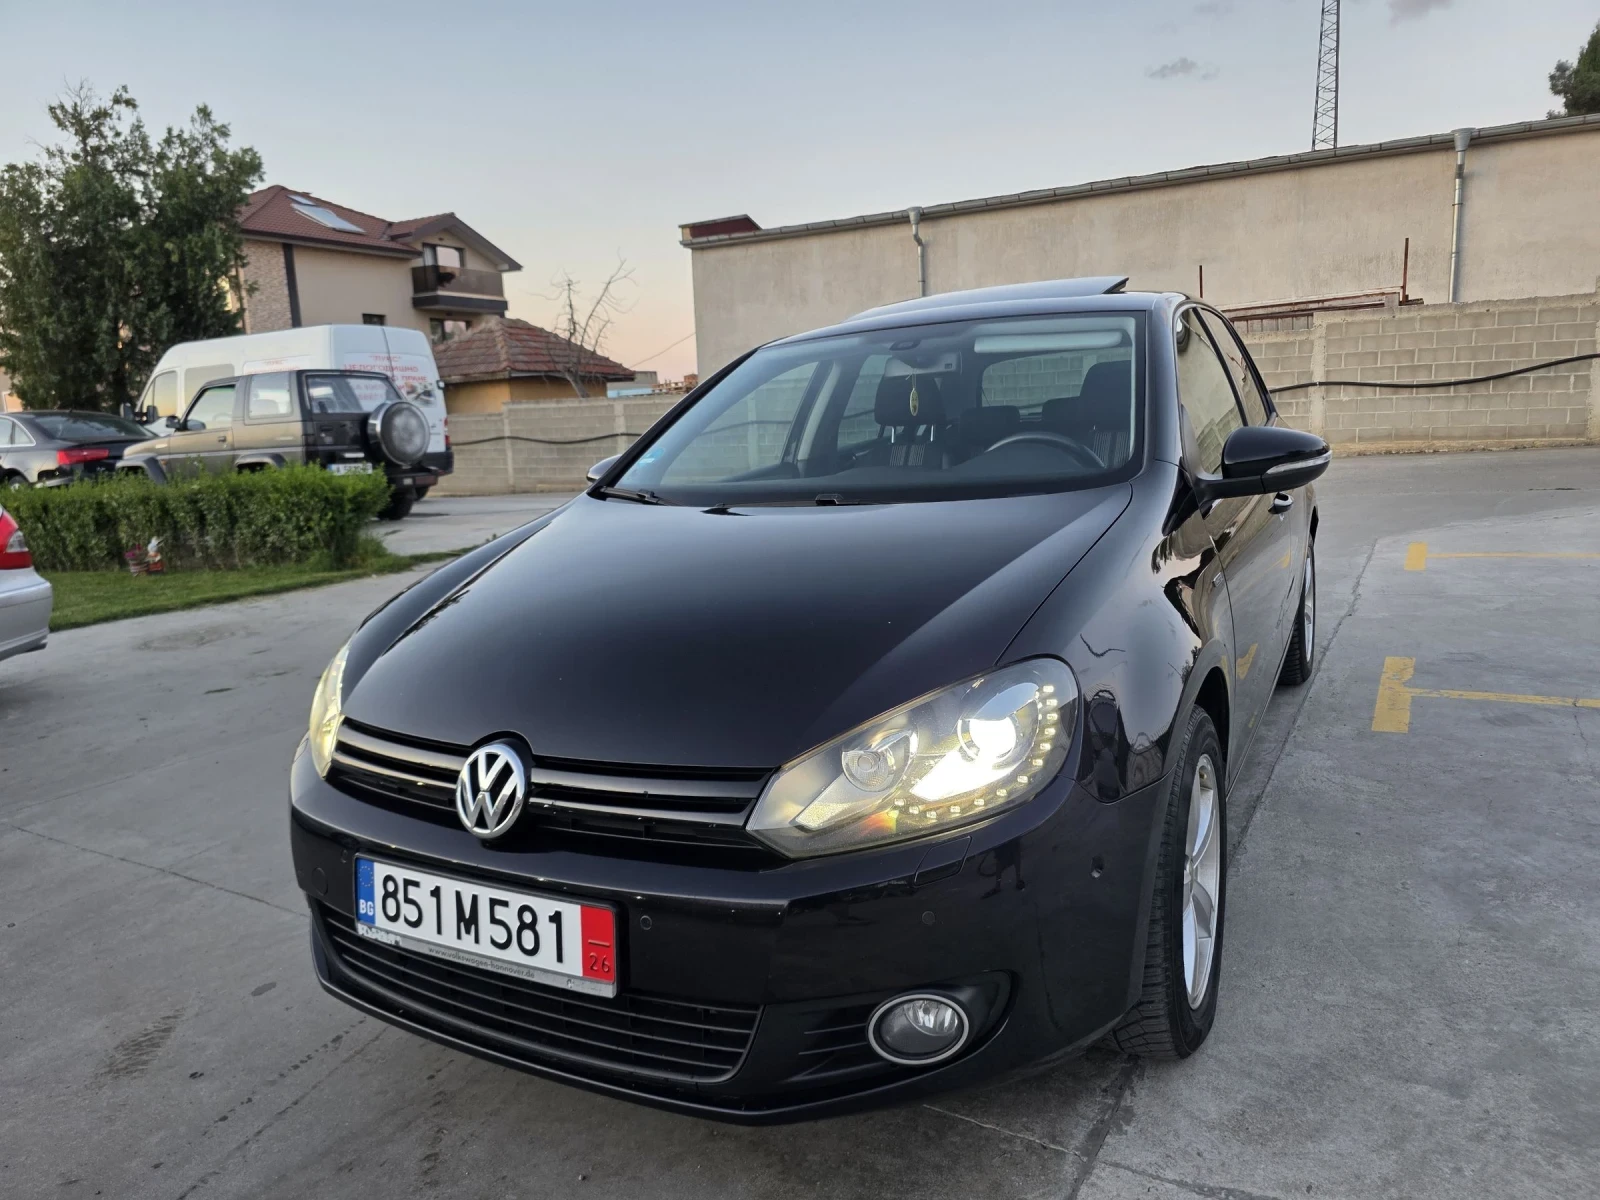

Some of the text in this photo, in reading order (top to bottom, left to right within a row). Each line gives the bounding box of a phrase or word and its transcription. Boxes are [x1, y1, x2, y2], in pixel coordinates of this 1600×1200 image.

[458, 747, 523, 834] VW
[359, 899, 375, 916] BG
[428, 946, 536, 980] www.volkswagen-hannover.de
[589, 951, 611, 974] 26
